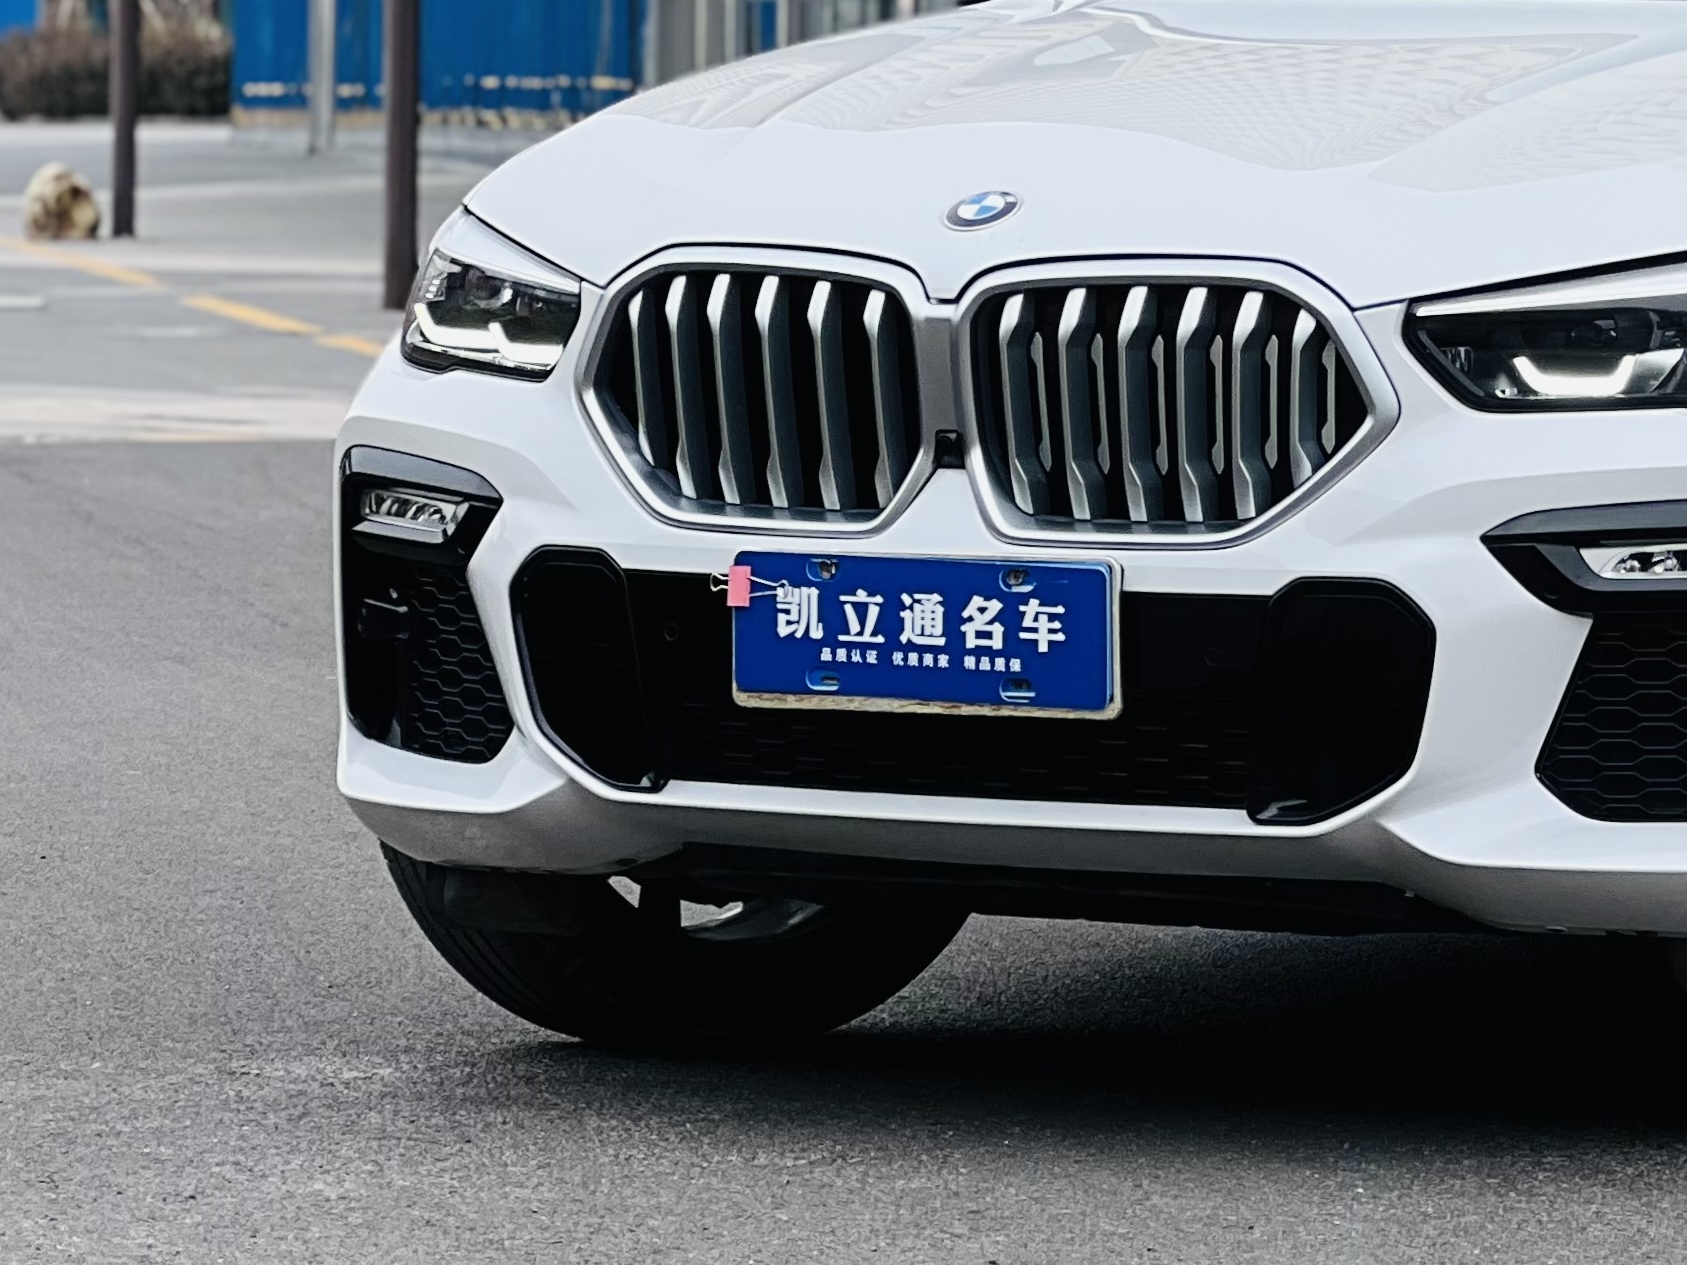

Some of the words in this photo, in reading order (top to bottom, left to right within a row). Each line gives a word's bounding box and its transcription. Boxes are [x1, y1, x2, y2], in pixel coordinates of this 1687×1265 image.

[776, 586, 1066, 653] 凯立通名车
[820, 647, 878, 664] 品质认证
[892, 651, 950, 669] 优质商家
[963, 655, 1022, 673] 精品质保
